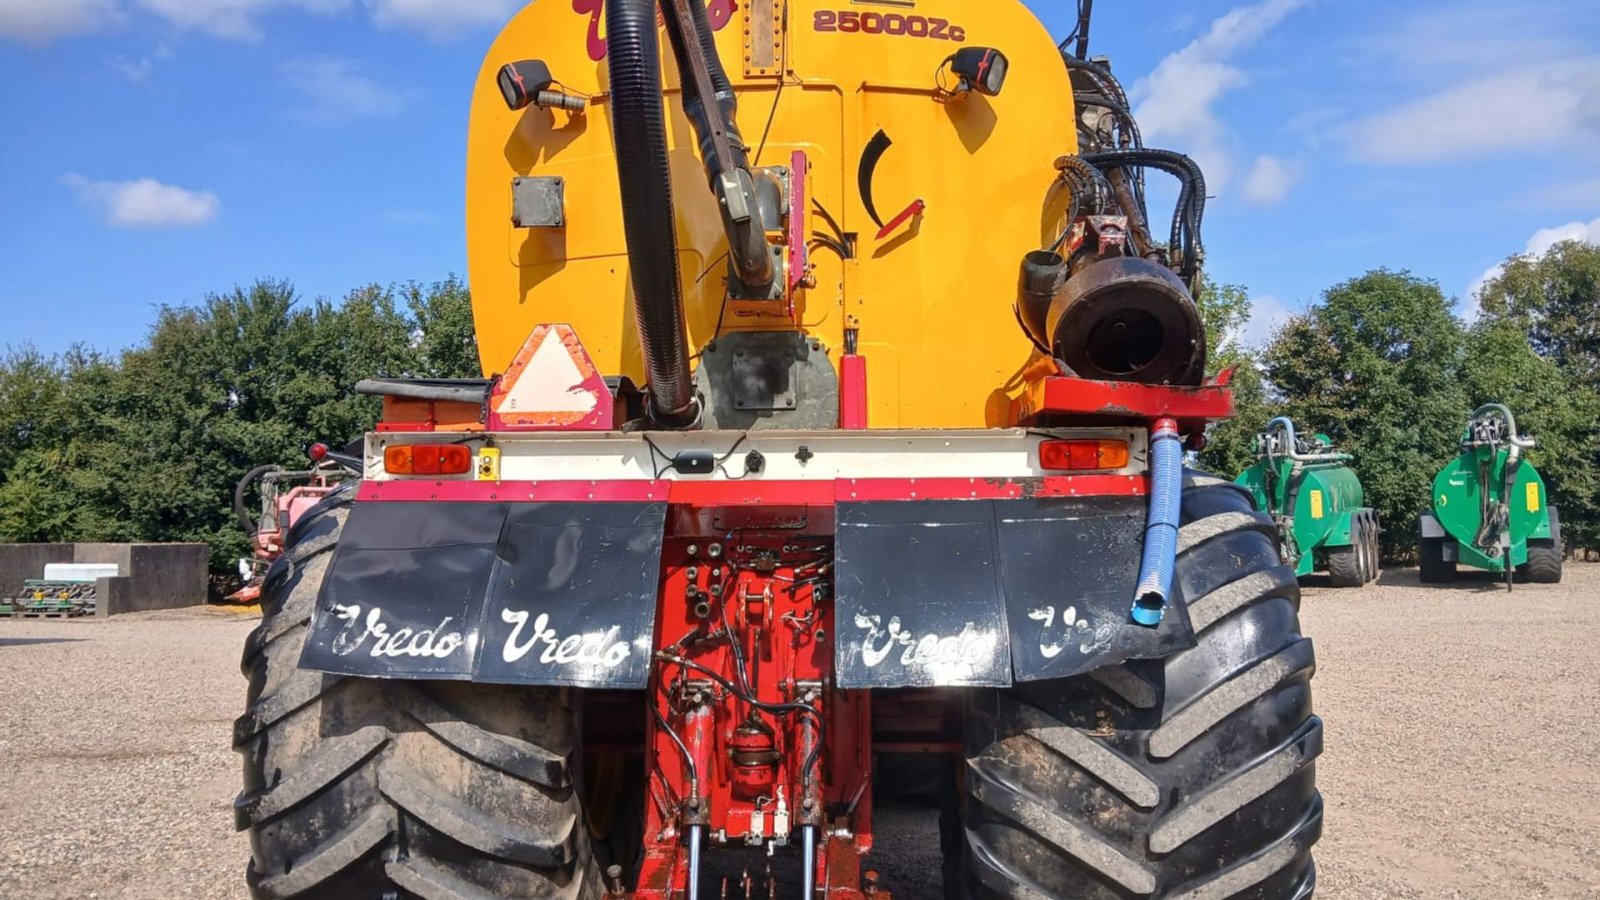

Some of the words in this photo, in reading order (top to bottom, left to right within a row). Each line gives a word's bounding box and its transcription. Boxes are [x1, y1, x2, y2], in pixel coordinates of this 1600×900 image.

[814, 10, 965, 42] 25000Zc
[333, 604, 463, 657] Vredo
[502, 607, 631, 667] Vredo
